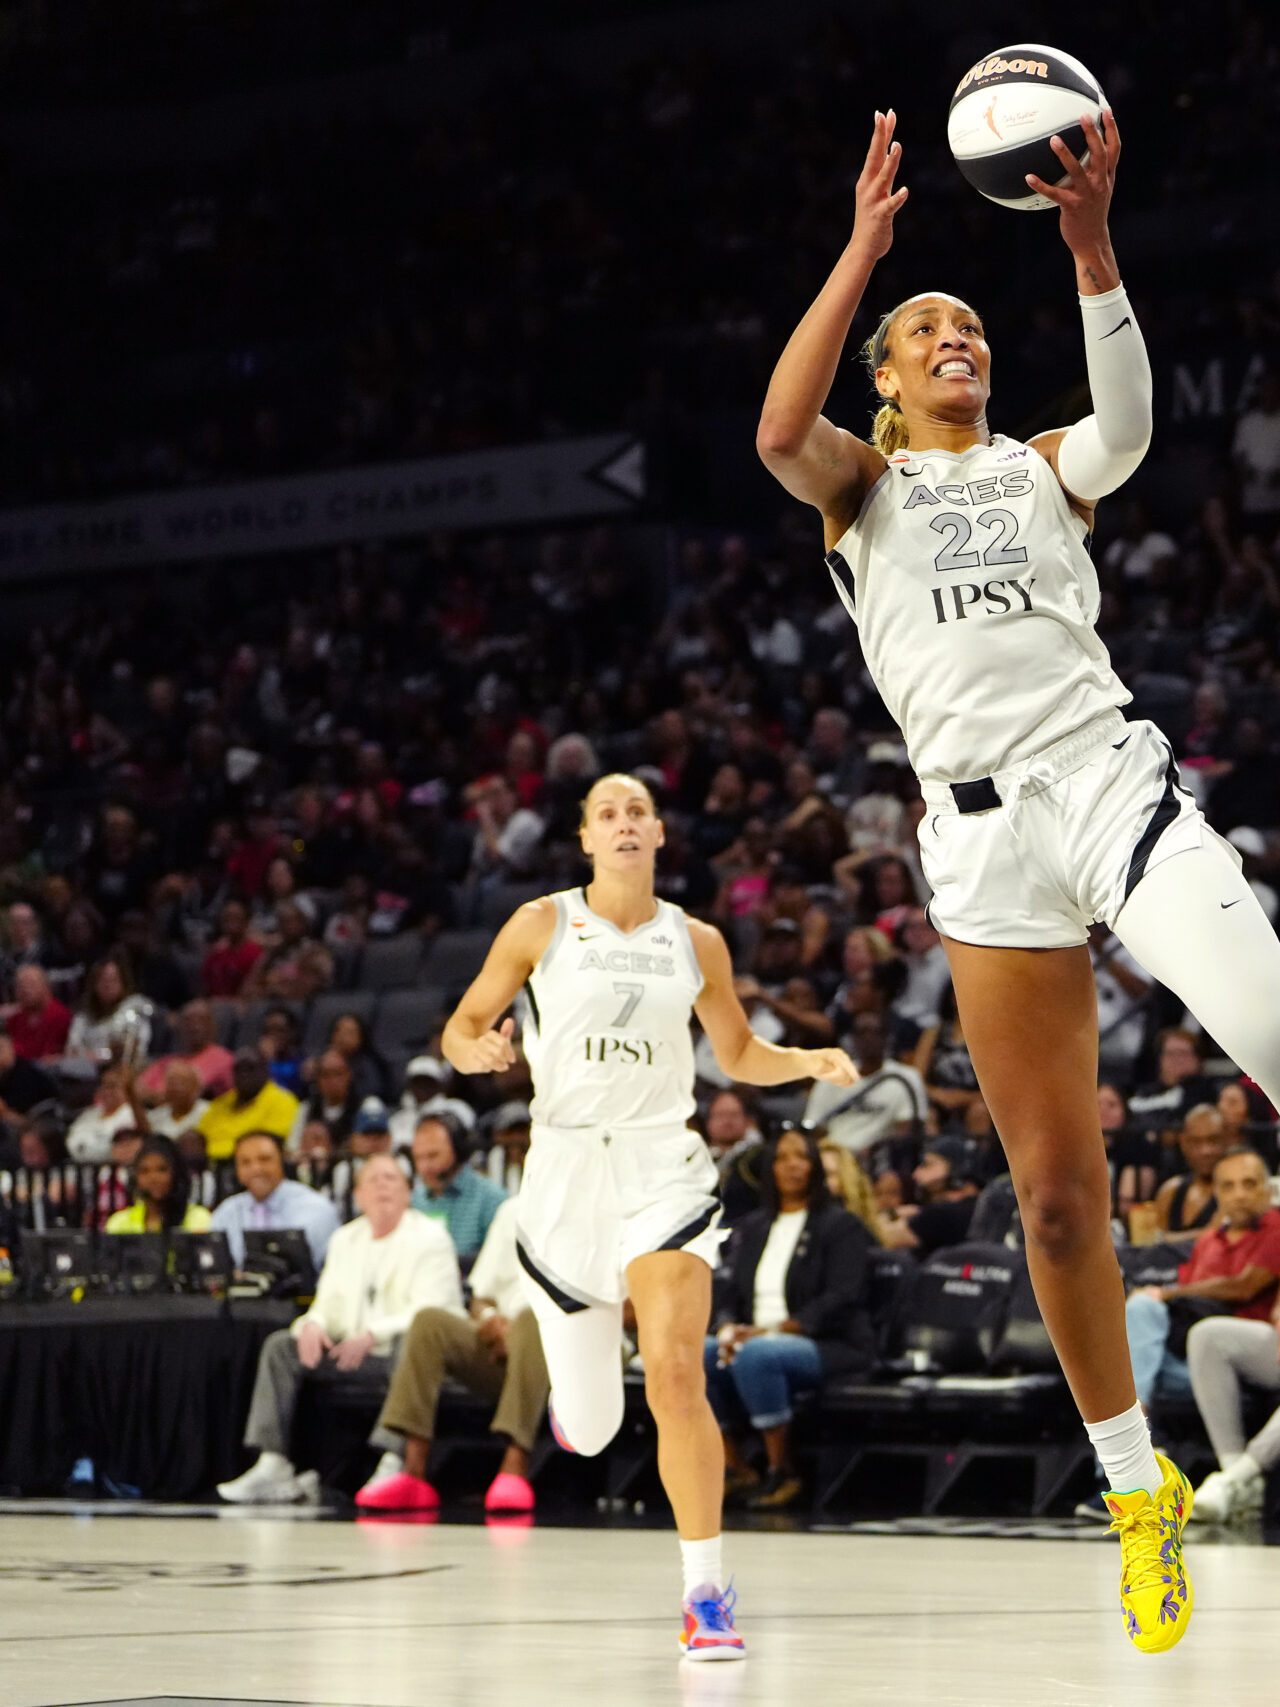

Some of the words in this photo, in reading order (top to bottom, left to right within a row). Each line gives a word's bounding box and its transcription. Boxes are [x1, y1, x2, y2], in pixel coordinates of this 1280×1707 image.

[996, 448, 1028, 464] ally
[165, 496, 308, 538] WORLD
[325, 472, 499, 523] CHAMPS
[902, 469, 1035, 510] ACES
[928, 508, 1029, 572] 22
[930, 578, 1037, 624] IPSY
[578, 949, 676, 977] ACES
[610, 981, 645, 1028] 7
[584, 1037, 663, 1066] IPSY
